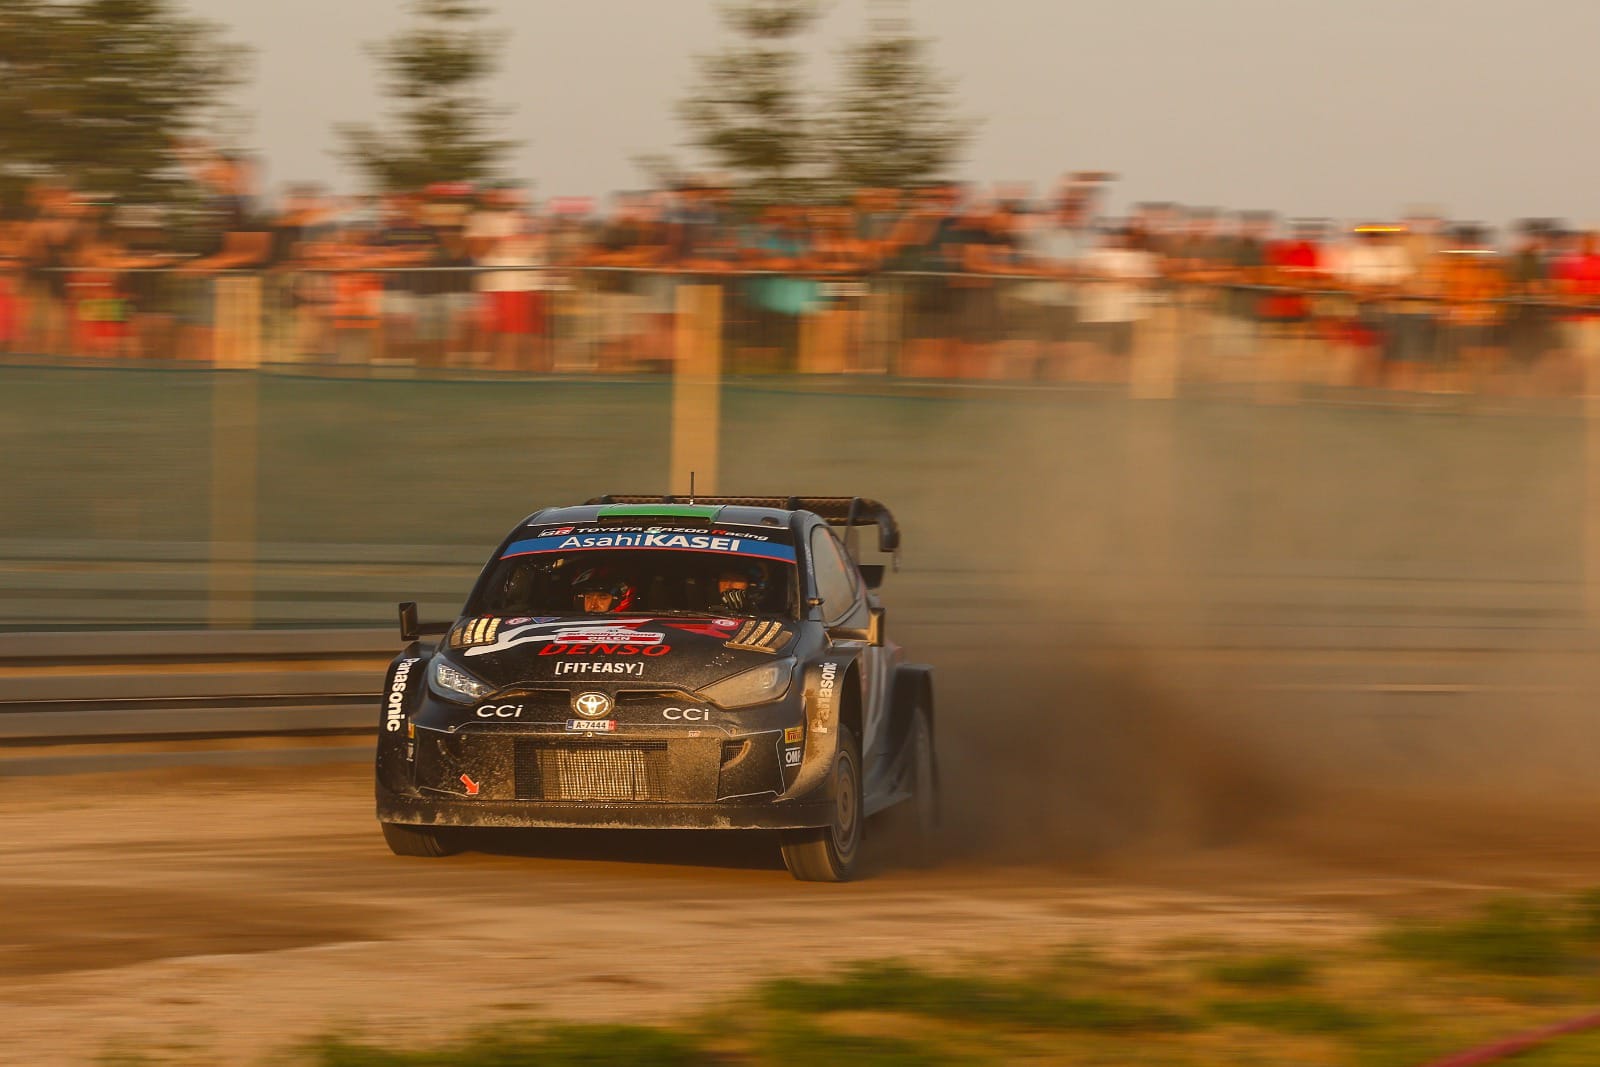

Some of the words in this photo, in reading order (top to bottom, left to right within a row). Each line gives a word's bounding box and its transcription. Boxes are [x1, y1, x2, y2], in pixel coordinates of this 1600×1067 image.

[711, 529, 769, 541] Racing
[538, 643, 671, 656] DENSO
[386, 657, 422, 732] Panasonic
[811, 662, 838, 734] Panasonic
[576, 721, 606, 729] A-7444
